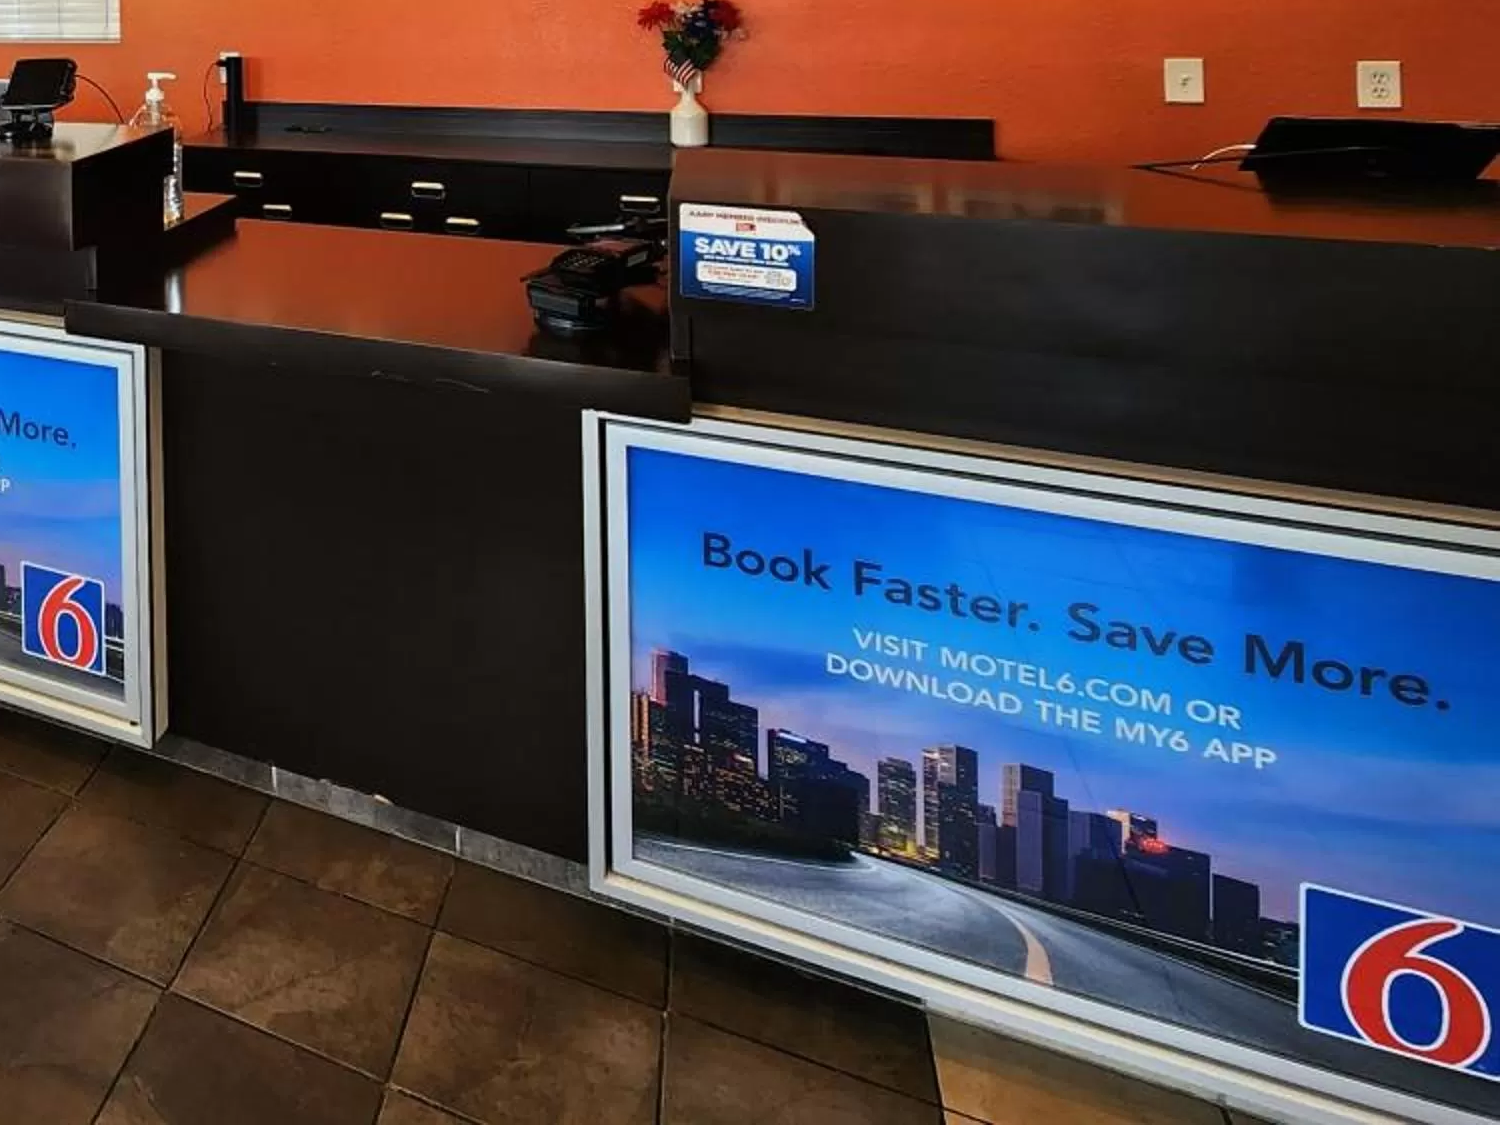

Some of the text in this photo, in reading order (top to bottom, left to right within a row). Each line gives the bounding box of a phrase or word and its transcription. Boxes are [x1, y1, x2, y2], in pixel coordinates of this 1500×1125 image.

[694, 237, 757, 258] SAVE
[760, 243, 801, 262] 10%
[38, 575, 99, 671] 6
[703, 531, 1451, 711] Book Faster. Save More.
[826, 652, 1278, 770] DOWNLOAD THE MY6 APP
[852, 628, 1242, 730] VISIT MOTEL6.COM OR
[1340, 917, 1492, 1068] 6
